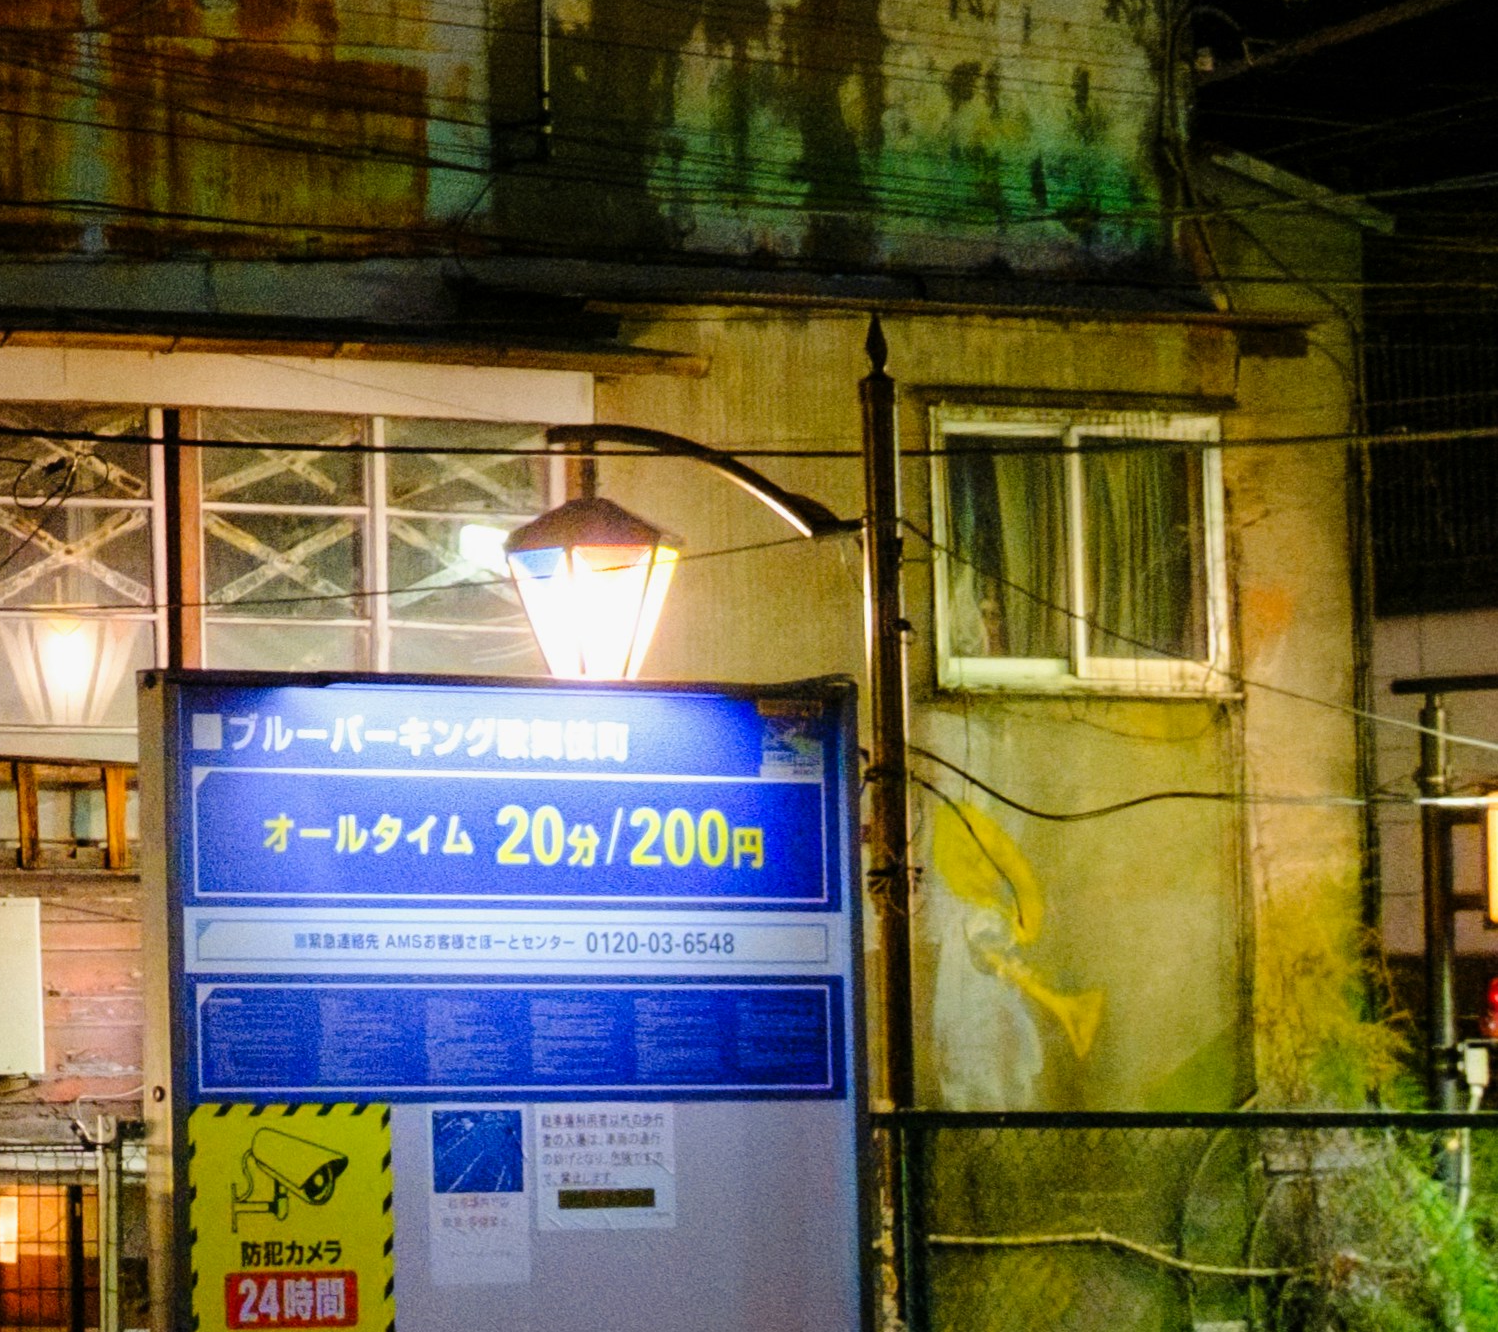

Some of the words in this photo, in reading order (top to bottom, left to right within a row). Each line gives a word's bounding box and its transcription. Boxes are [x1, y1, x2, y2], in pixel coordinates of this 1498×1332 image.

[262, 810, 473, 855] オールタイム
[496, 804, 766, 870] 20分/200円
[586, 931, 735, 954] 0120-03-6548
[240, 1240, 343, 1267] 防犯カメラ
[238, 1277, 346, 1323] 24時間
